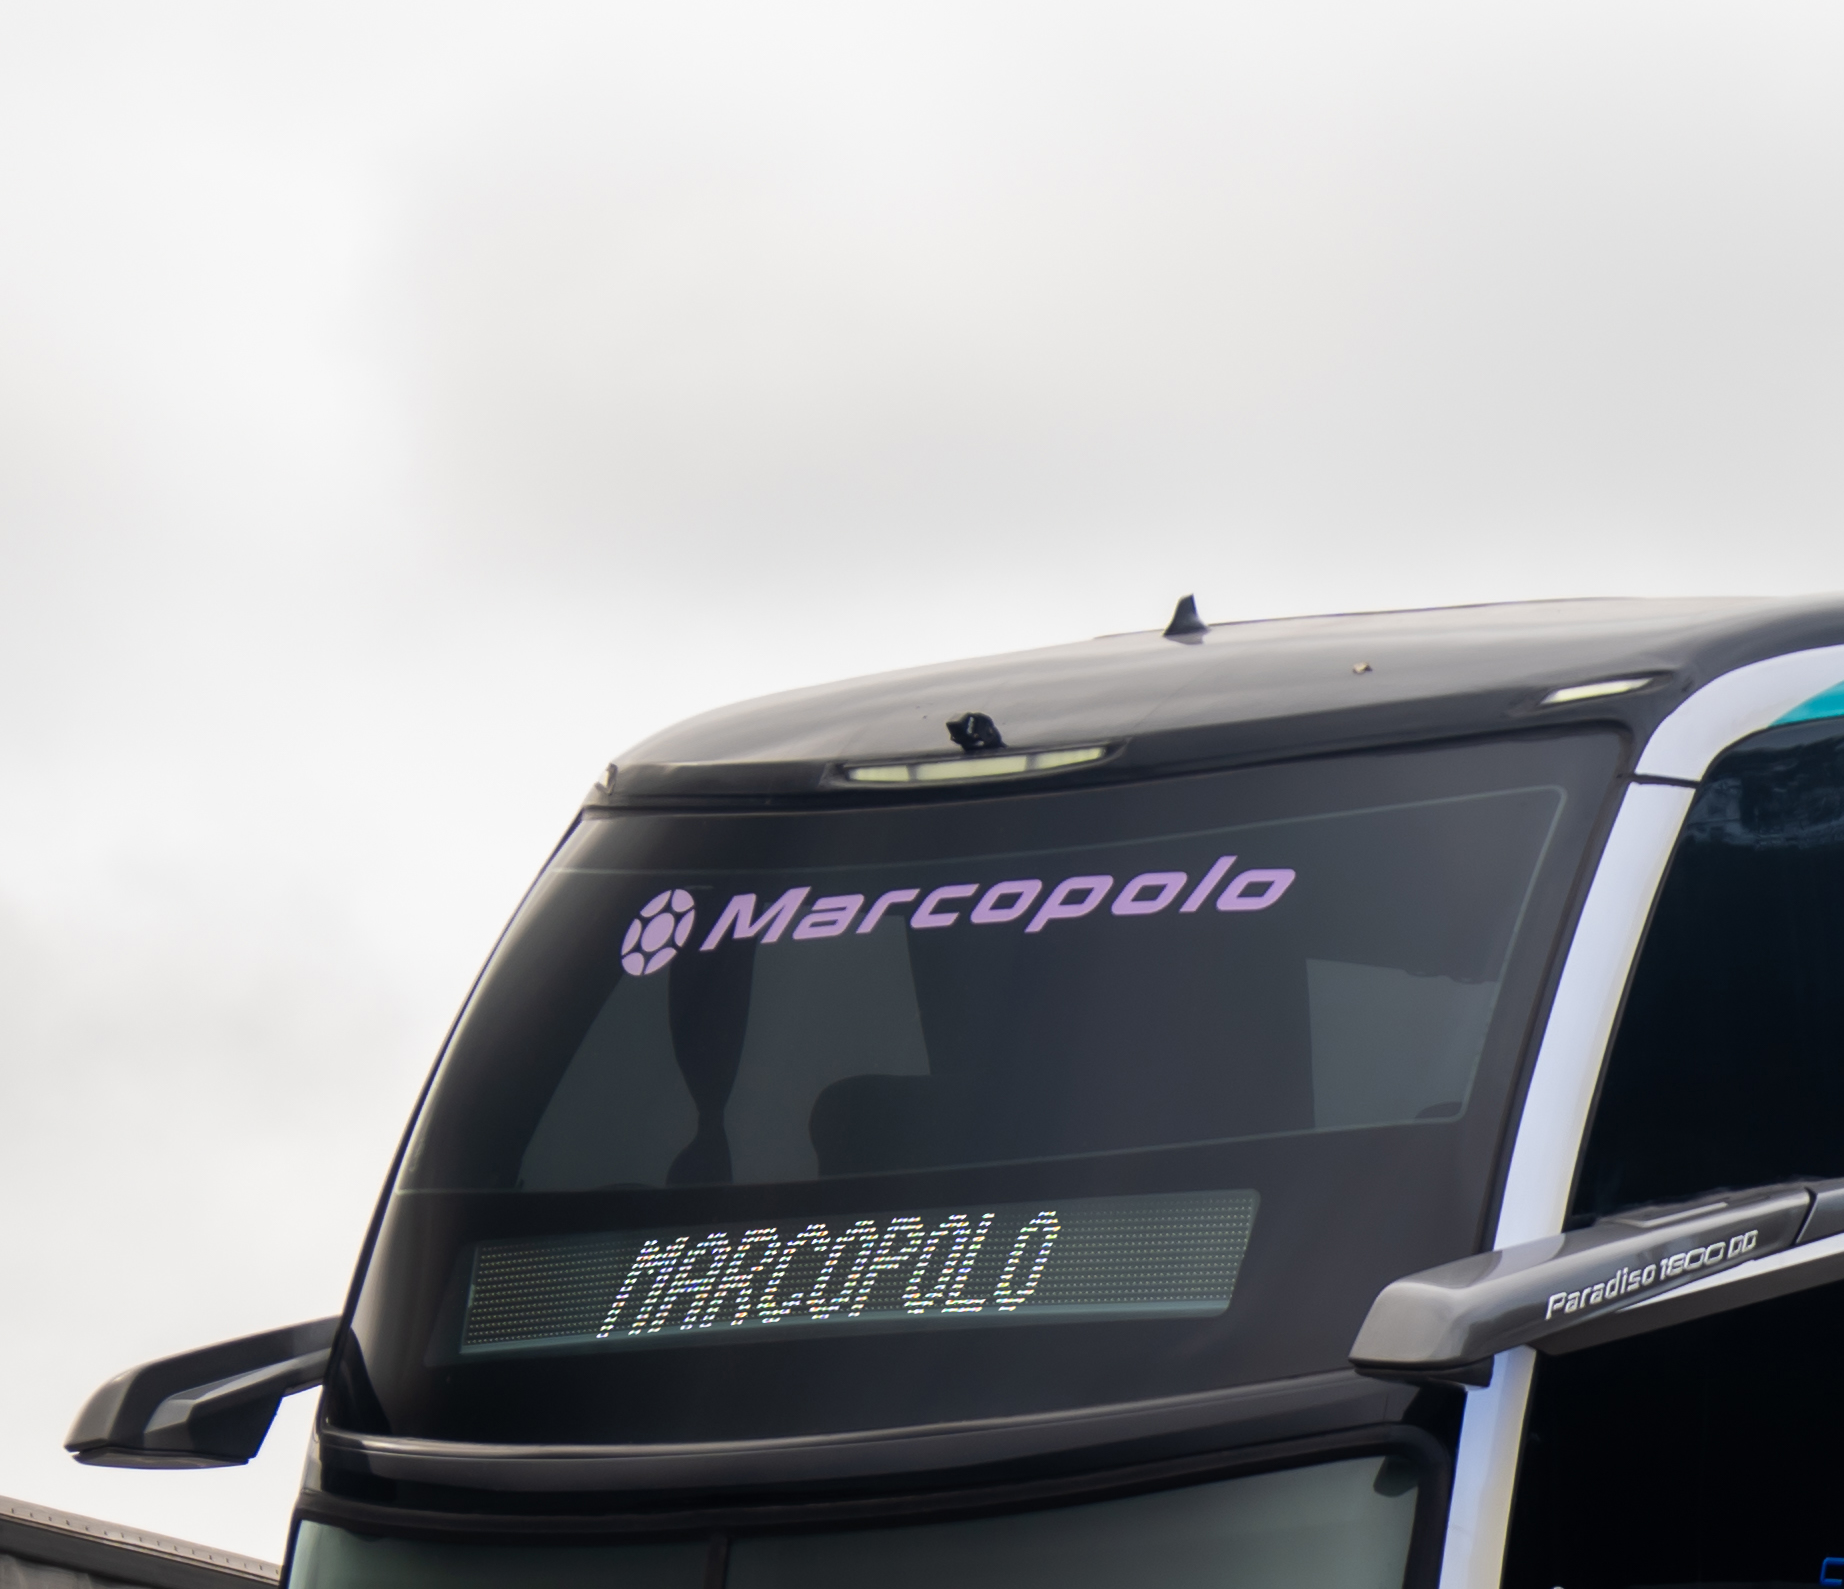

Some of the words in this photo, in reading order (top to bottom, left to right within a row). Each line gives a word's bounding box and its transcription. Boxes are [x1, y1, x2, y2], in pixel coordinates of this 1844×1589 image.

[700, 856, 1296, 951] Marcopolo
[597, 1211, 1061, 1338] MARCOPOLO
[1545, 1264, 1656, 1320] Paradiso
[1727, 1230, 1759, 1259] DD
